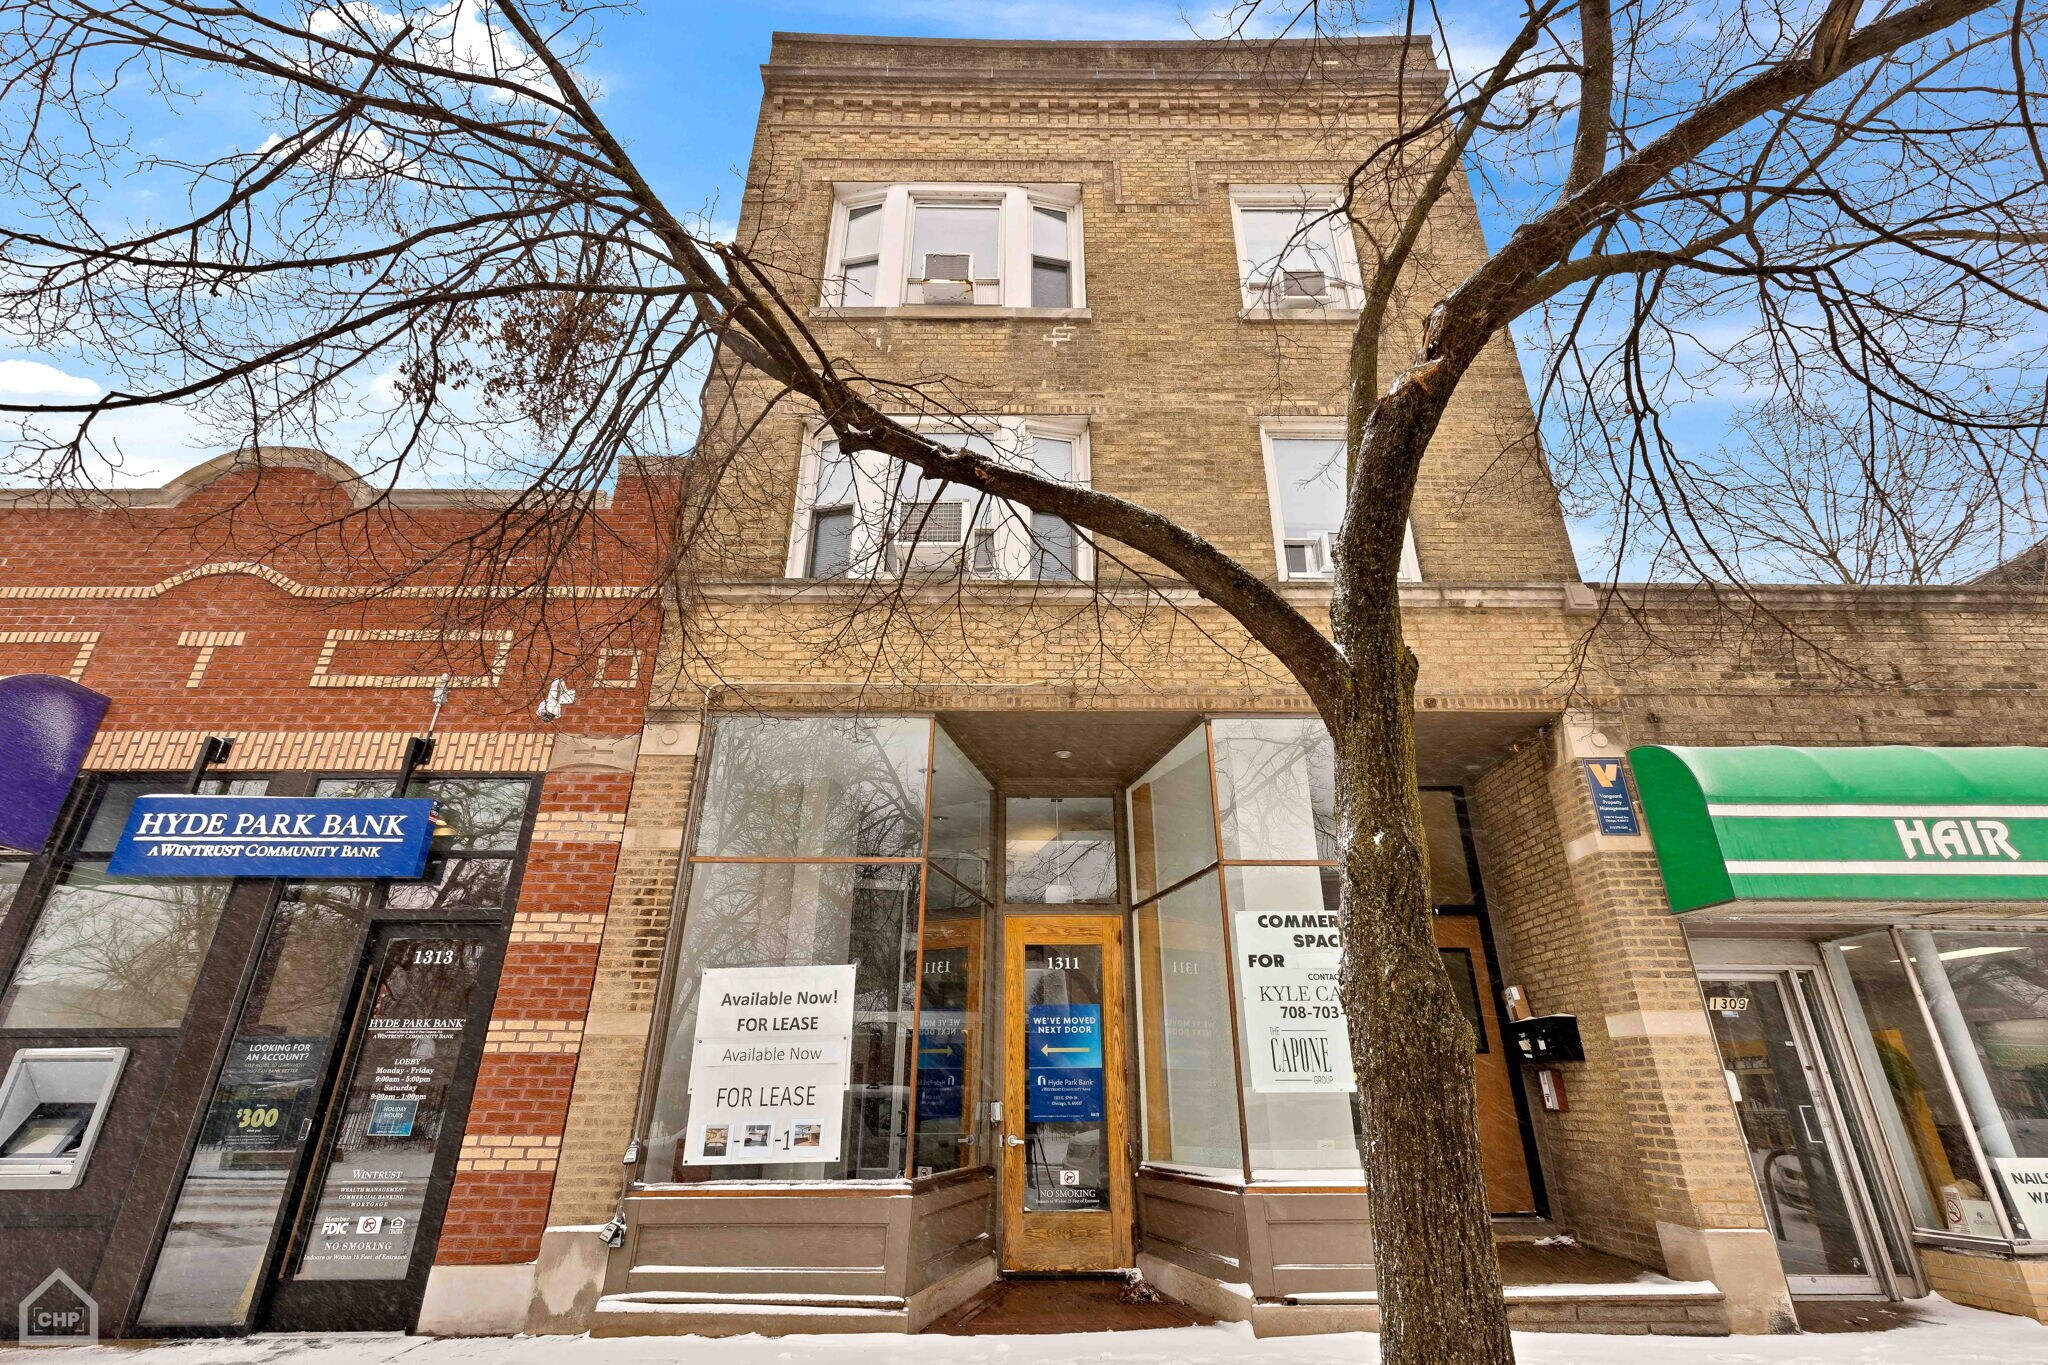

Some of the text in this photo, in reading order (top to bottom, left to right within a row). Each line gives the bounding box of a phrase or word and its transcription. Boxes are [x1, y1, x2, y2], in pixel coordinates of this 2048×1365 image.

[136, 813, 409, 836] HYDE PARK BANK
[1893, 819, 2021, 861] HAIR
[147, 843, 381, 858] A WINTRUST COMMUNITY BANK
[413, 950, 454, 965] 1313
[1047, 957, 1080, 970] 1311
[1248, 954, 1285, 968] FOR
[721, 990, 838, 1007] Available Now!
[1258, 985, 1310, 1001] KYLE
[1713, 998, 1746, 1010] 1309
[369, 1019, 464, 1028] HYDE PARK BANK
[737, 1017, 819, 1032] FOR LEASE
[1033, 1017, 1096, 1025] WE'VE MOVED
[1269, 1027, 1280, 1035] THE
[249, 1044, 292, 1052] LOOKING
[722, 1047, 822, 1062] Available Now
[1270, 1037, 1332, 1072] CAPONE
[245, 1053, 310, 1061] AN ACCOUNT?
[376, 1067, 405, 1075] Monday
[410, 1067, 435, 1075] Friday
[405, 1075, 431, 1083] 5:00pm
[1048, 1079, 1063, 1087] Hyde
[1313, 1076, 1333, 1084] GROUP
[716, 1086, 817, 1108] FOR LEASE
[236, 1108, 279, 1128] $300
[352, 1169, 403, 1179] WINTRUST
[1040, 1189, 1096, 1198] NO SMOKING
[320, 1222, 350, 1235] FDIC
[324, 1242, 392, 1250] NO SMOKING
